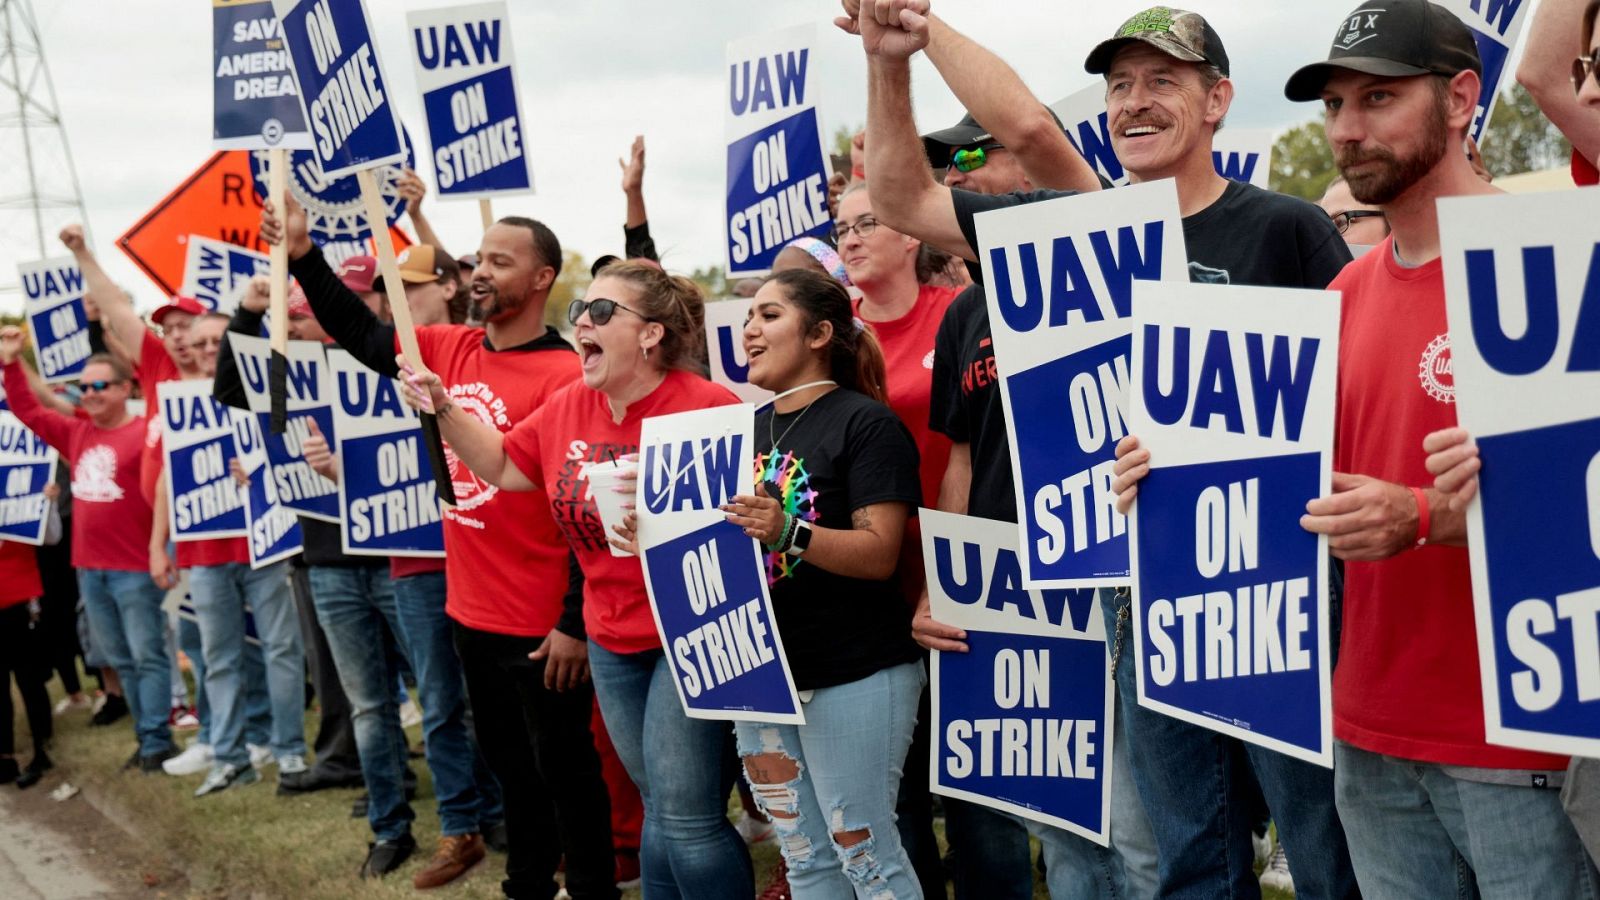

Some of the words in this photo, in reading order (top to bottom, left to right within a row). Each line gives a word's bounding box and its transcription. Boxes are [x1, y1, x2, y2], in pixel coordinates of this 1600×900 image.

[305, 0, 343, 76] ON
[414, 19, 501, 71] UAW
[1338, 13, 1380, 38] FOX
[310, 41, 385, 162] STRIKE
[451, 81, 489, 135] ON
[730, 48, 809, 117] UAW
[435, 115, 522, 190] STRIKE
[752, 129, 789, 195] ON
[730, 172, 830, 265] STRIKE
[23, 267, 83, 299] UAW
[195, 246, 223, 312] UAW
[989, 220, 1164, 333] UAW
[50, 303, 79, 341] ON
[338, 371, 421, 418] UA
[1068, 353, 1131, 454] ON
[1142, 323, 1321, 443] UAW
[5, 466, 34, 498] ON
[192, 441, 225, 485] ON
[377, 436, 420, 488] ON
[644, 433, 744, 515] UAW
[349, 480, 444, 543] STRIK
[1195, 477, 1260, 579] ON
[682, 538, 727, 616] ON
[673, 598, 775, 699] STRIKE
[1147, 576, 1311, 688] STRIKE
[993, 648, 1050, 709] ON
[946, 718, 1096, 780] STRIKE
